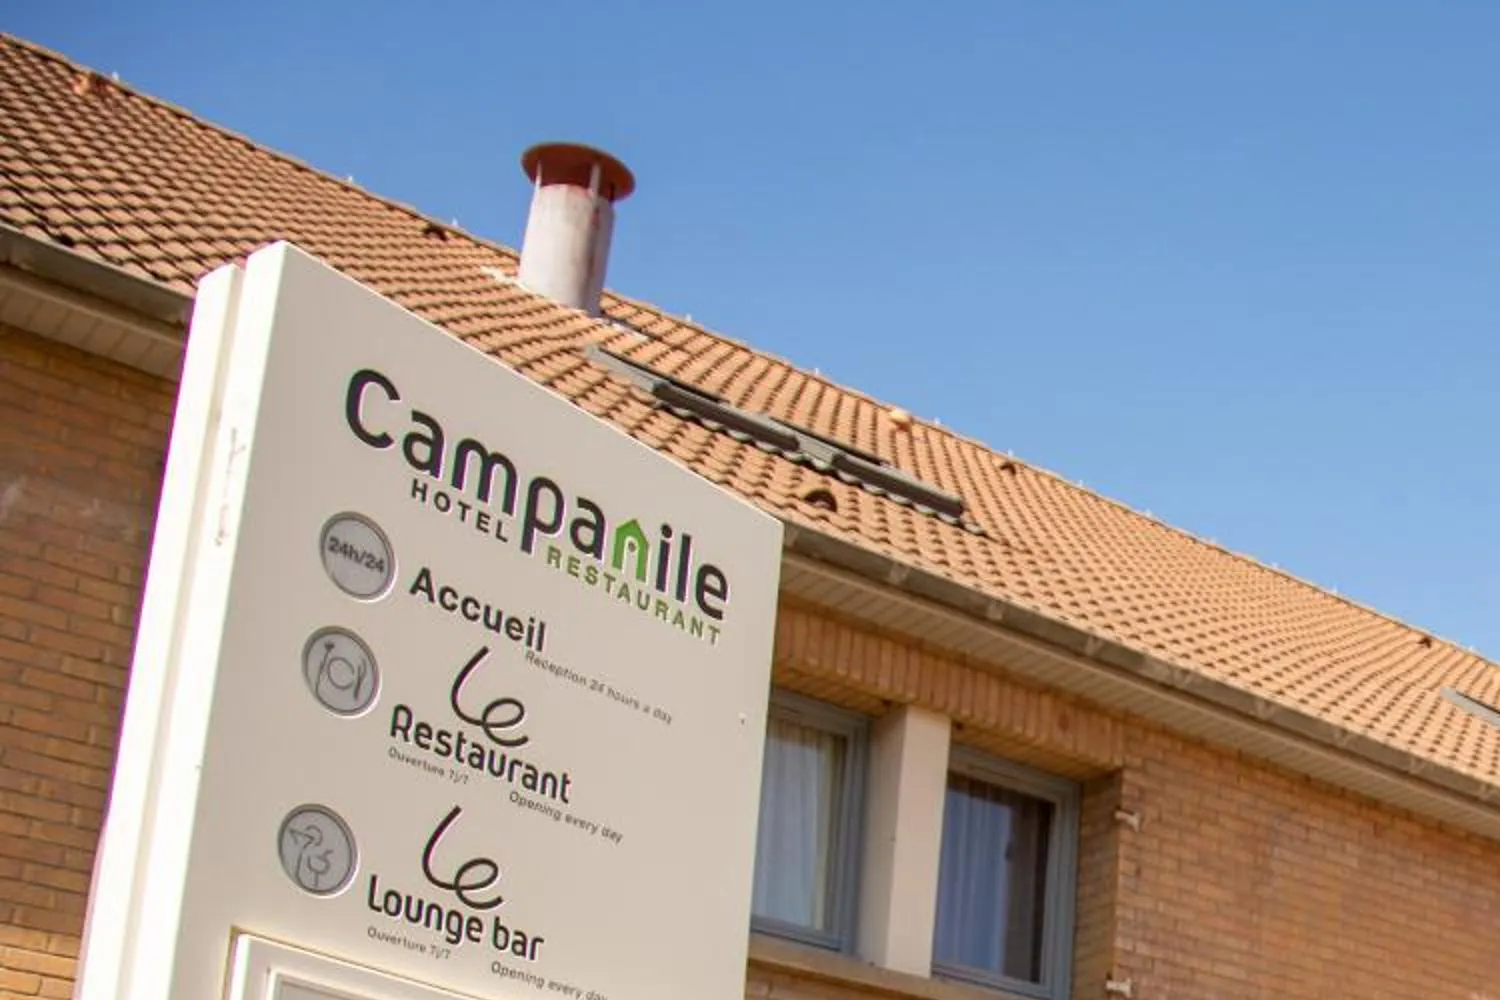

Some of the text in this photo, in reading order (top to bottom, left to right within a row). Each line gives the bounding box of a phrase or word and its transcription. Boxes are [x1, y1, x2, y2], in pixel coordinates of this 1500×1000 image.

[346, 369, 729, 620] Campanile
[328, 535, 384, 573] 24h/24
[411, 478, 722, 646] HOTEL RESTAURANT
[409, 567, 547, 652] Accueil
[450, 645, 529, 747] Le
[389, 747, 445, 777] Ouverture
[390, 703, 572, 804] Restaurant
[421, 804, 505, 910] Le
[509, 791, 624, 845] Opening every day
[367, 873, 545, 961] Lounge bar
[367, 926, 427, 954] Ouverture
[491, 961, 545, 990] Opening
[548, 980, 584, 1000] every
